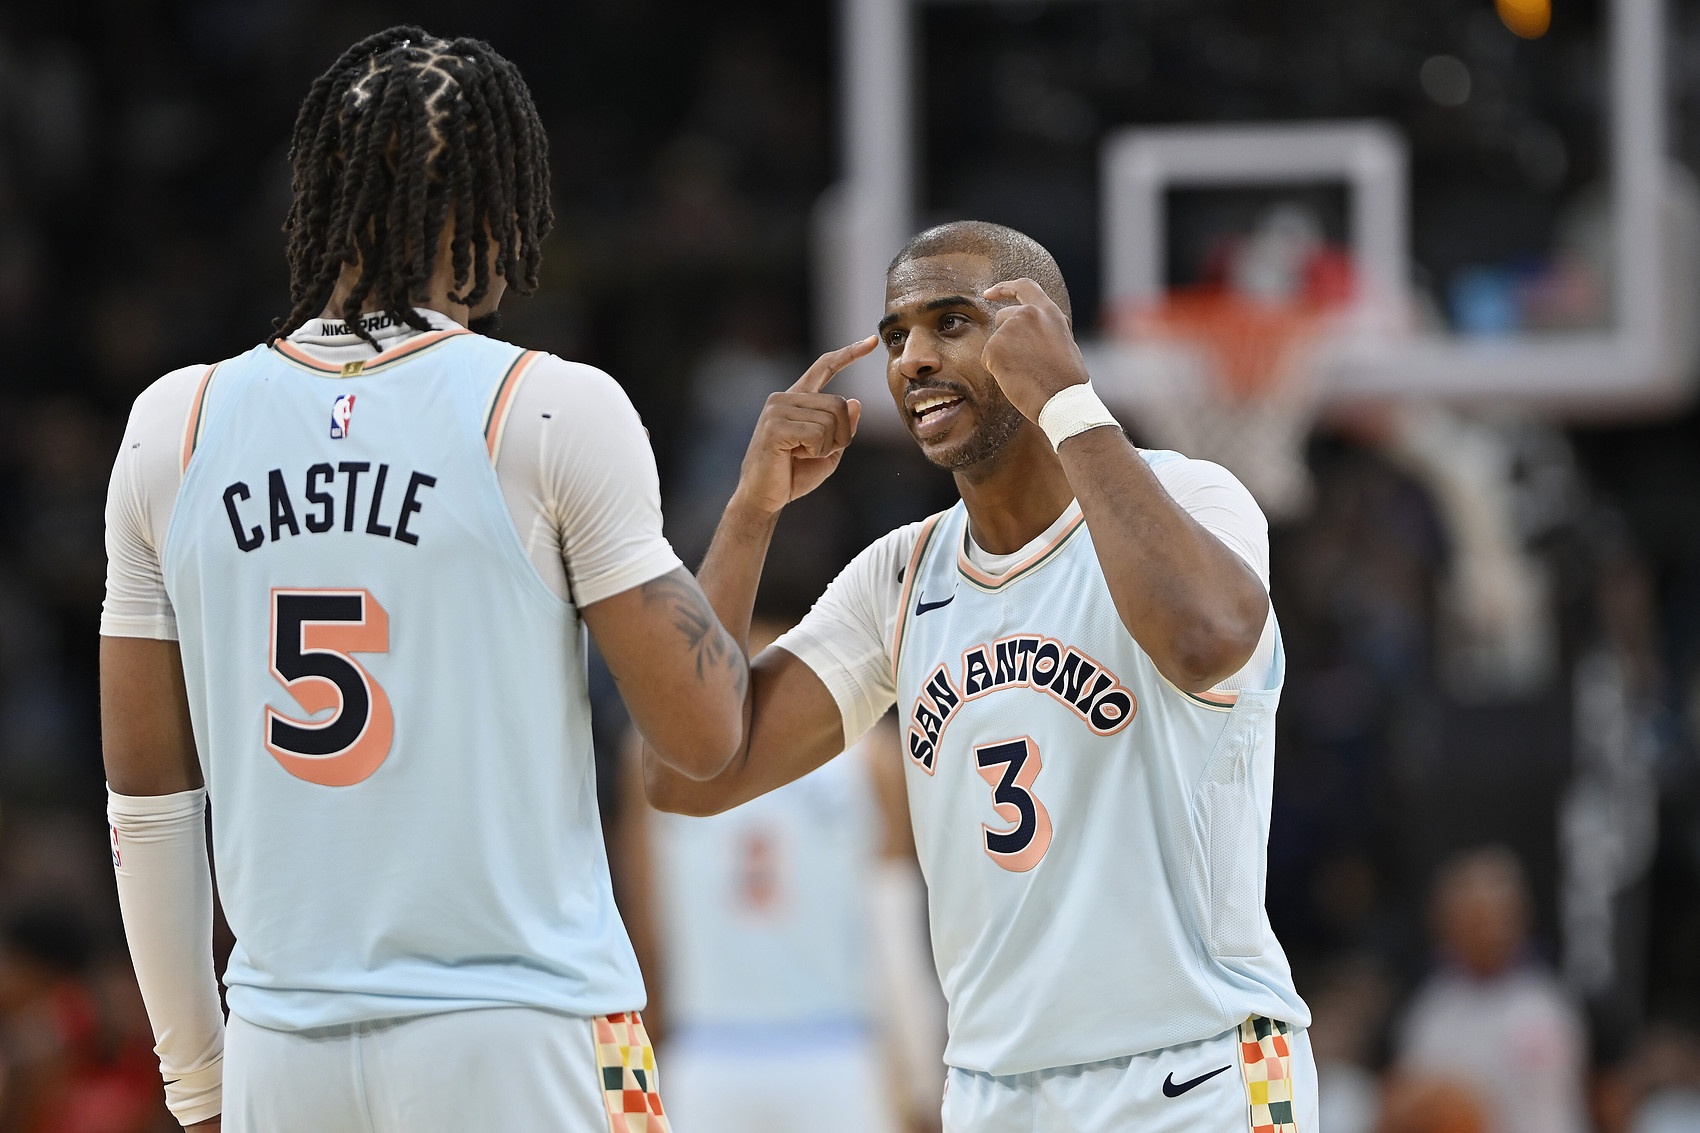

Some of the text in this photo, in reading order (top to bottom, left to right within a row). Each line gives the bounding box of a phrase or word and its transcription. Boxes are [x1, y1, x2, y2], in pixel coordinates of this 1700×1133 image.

[222, 461, 438, 553] CASTLE
[267, 589, 376, 764] 5
[908, 636, 1134, 773] SAN ANTONIO
[974, 737, 1040, 858] 3
